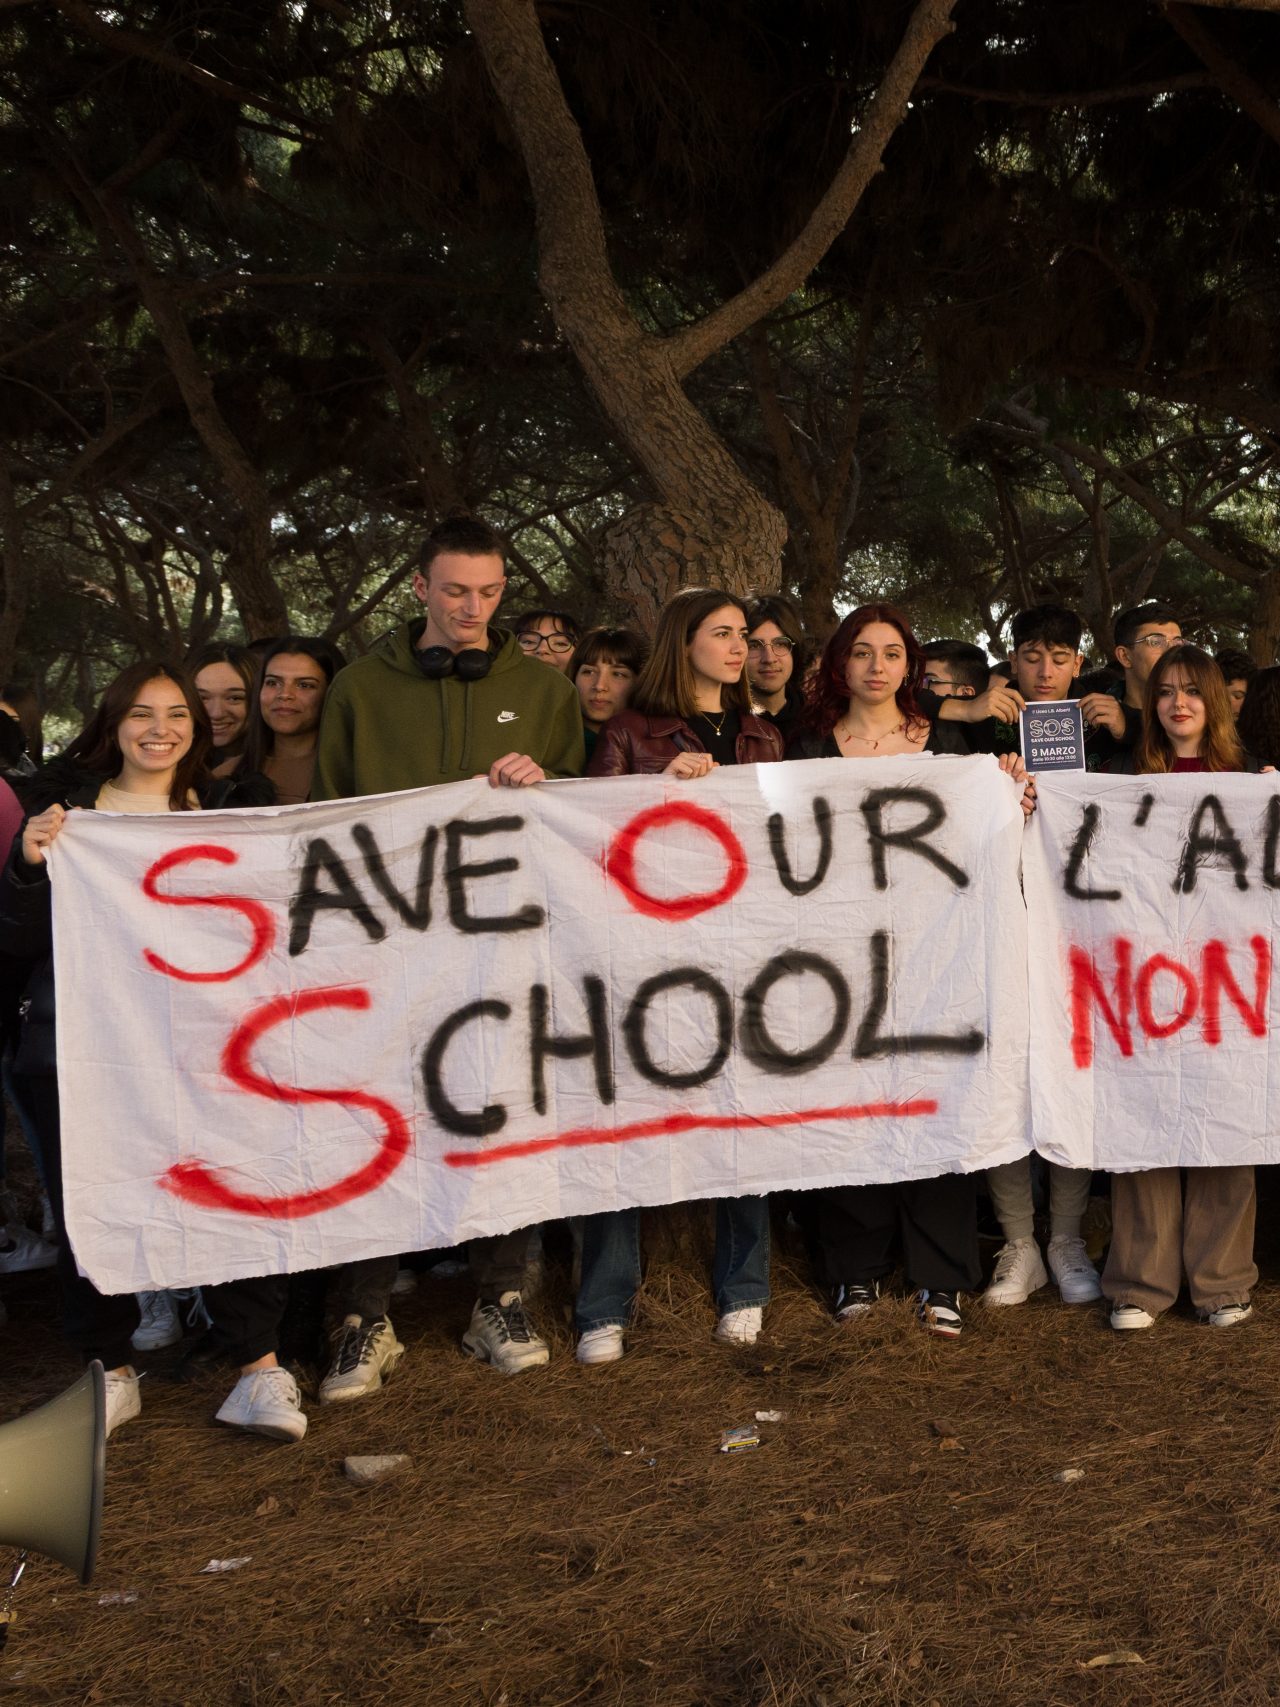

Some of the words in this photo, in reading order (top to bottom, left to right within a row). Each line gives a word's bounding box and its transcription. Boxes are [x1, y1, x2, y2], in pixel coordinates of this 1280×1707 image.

[1030, 718, 1075, 737] SOS
[1031, 748, 1038, 757] 9
[1040, 747, 1076, 756] MARZO
[140, 814, 545, 985] SAVE
[602, 785, 970, 923] OUR
[1067, 932, 1274, 1071] NON
[156, 930, 986, 1220] SCHOOL
